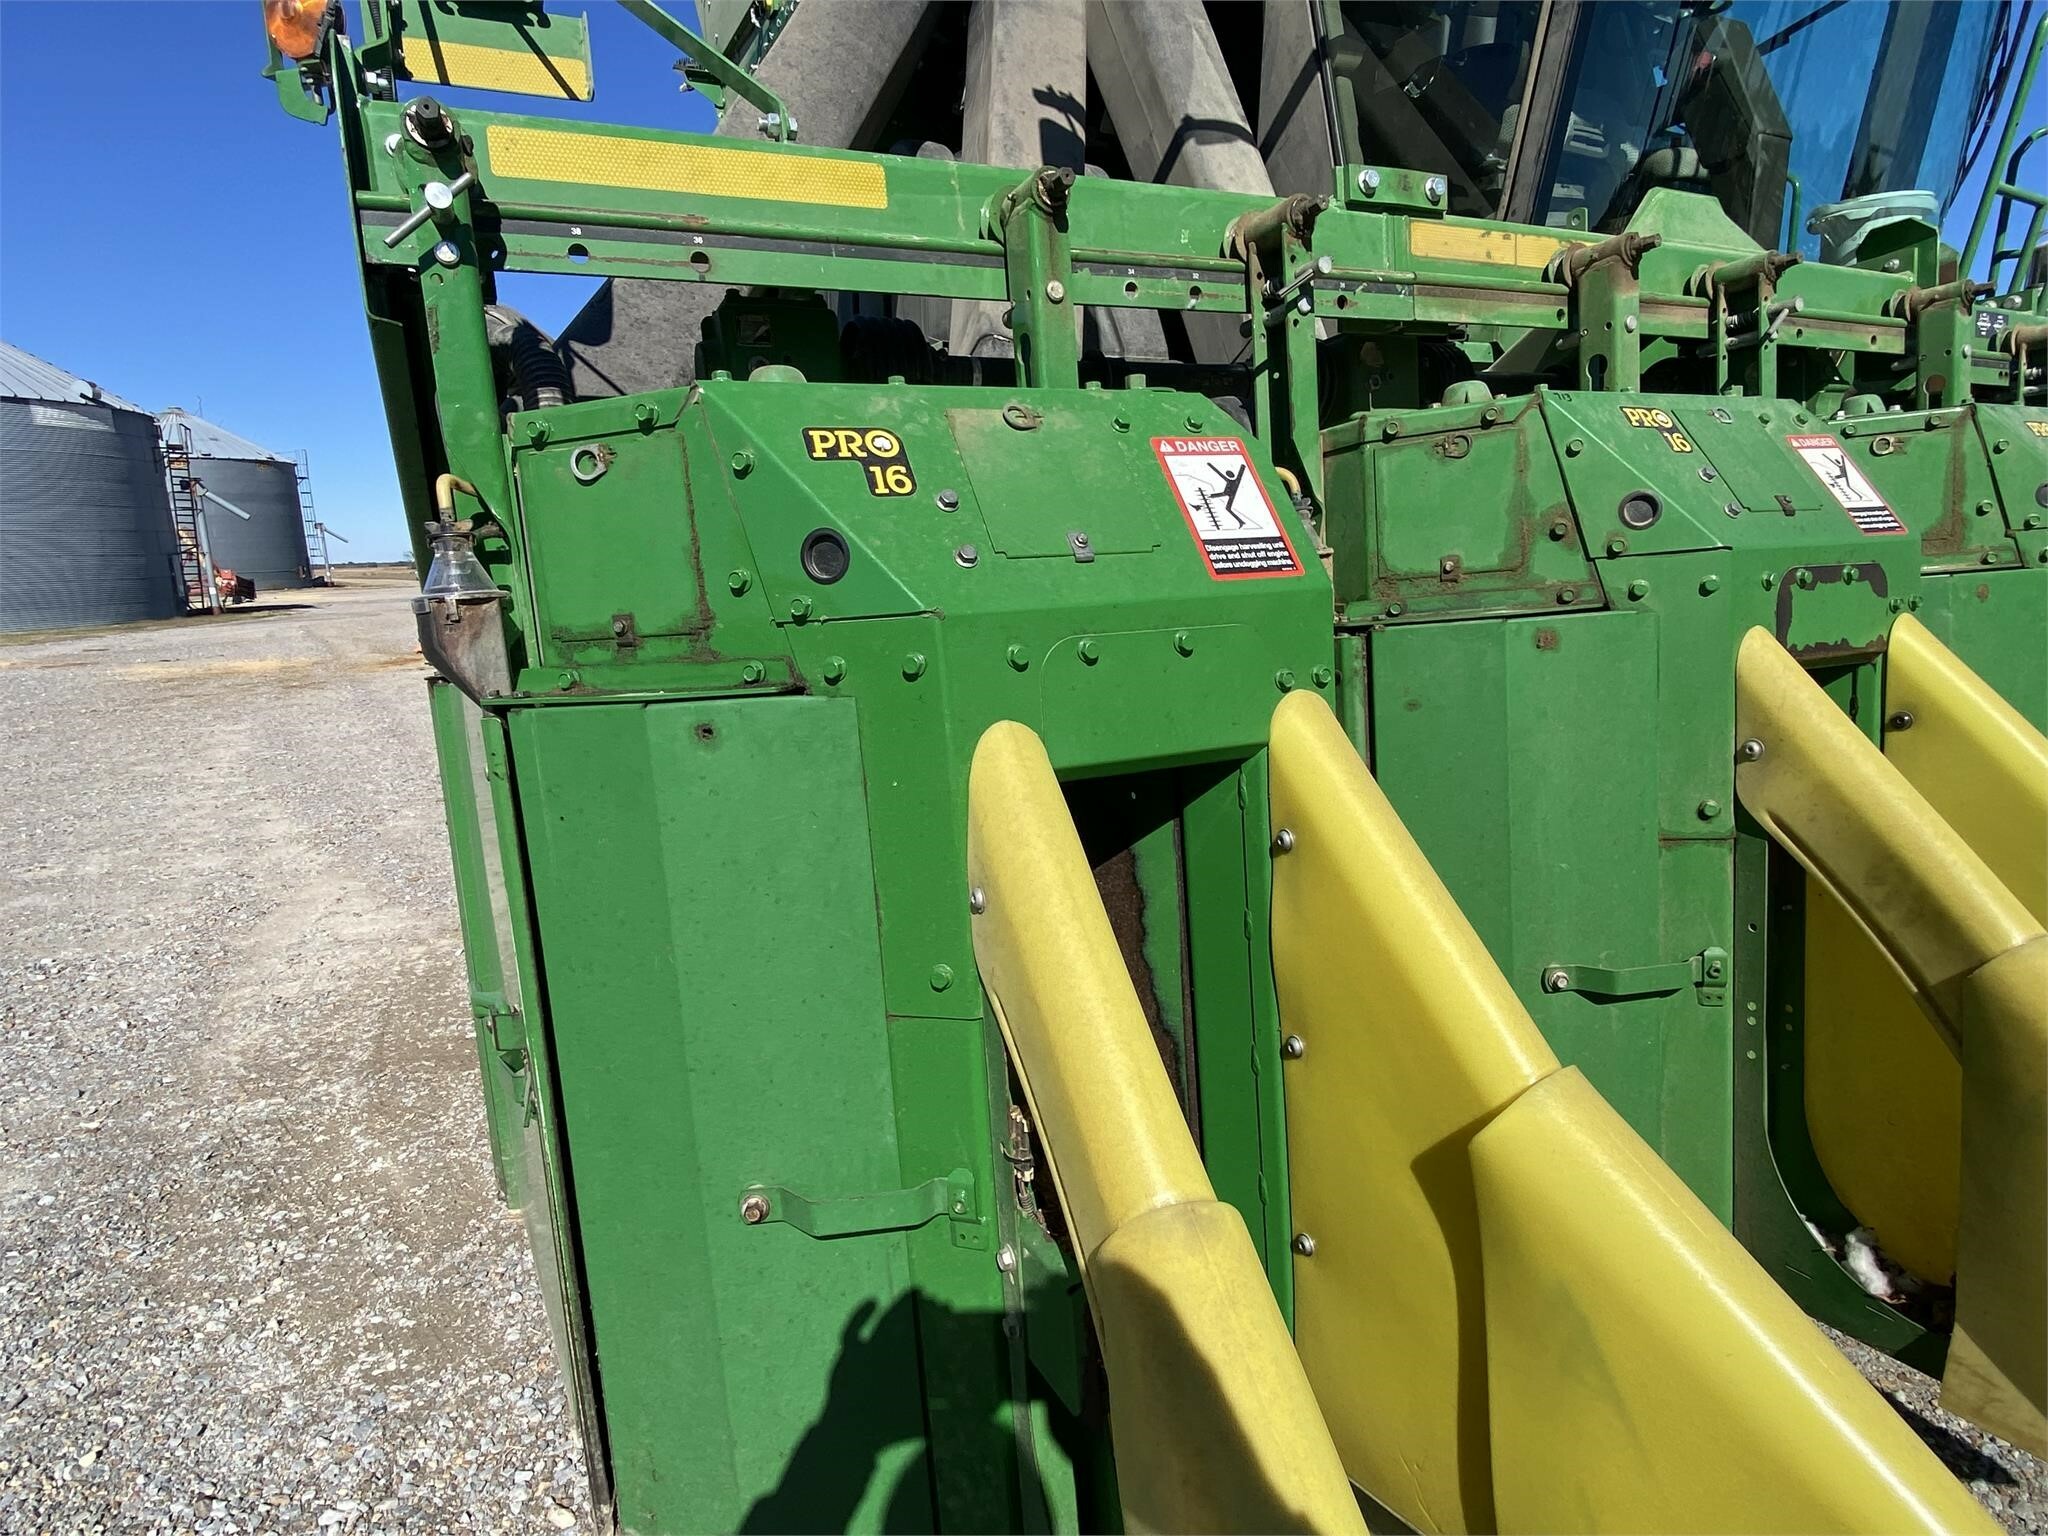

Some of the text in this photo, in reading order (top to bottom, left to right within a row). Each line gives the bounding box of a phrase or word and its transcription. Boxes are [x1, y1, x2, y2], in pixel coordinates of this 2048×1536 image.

[1622, 407, 1674, 429] PRO
[808, 429, 901, 458] PRO
[1174, 440, 1241, 453] DANGER
[1662, 432, 1692, 453] 16
[1797, 437, 1836, 447] DANGER
[868, 465, 913, 494] 16
[1204, 544, 1239, 552] Disengage
[1239, 542, 1273, 550] harvesting
[1227, 552, 1241, 560] and
[1241, 551, 1257, 559] shut
[1267, 550, 1290, 558] engine
[1233, 560, 1268, 569] unclogging
